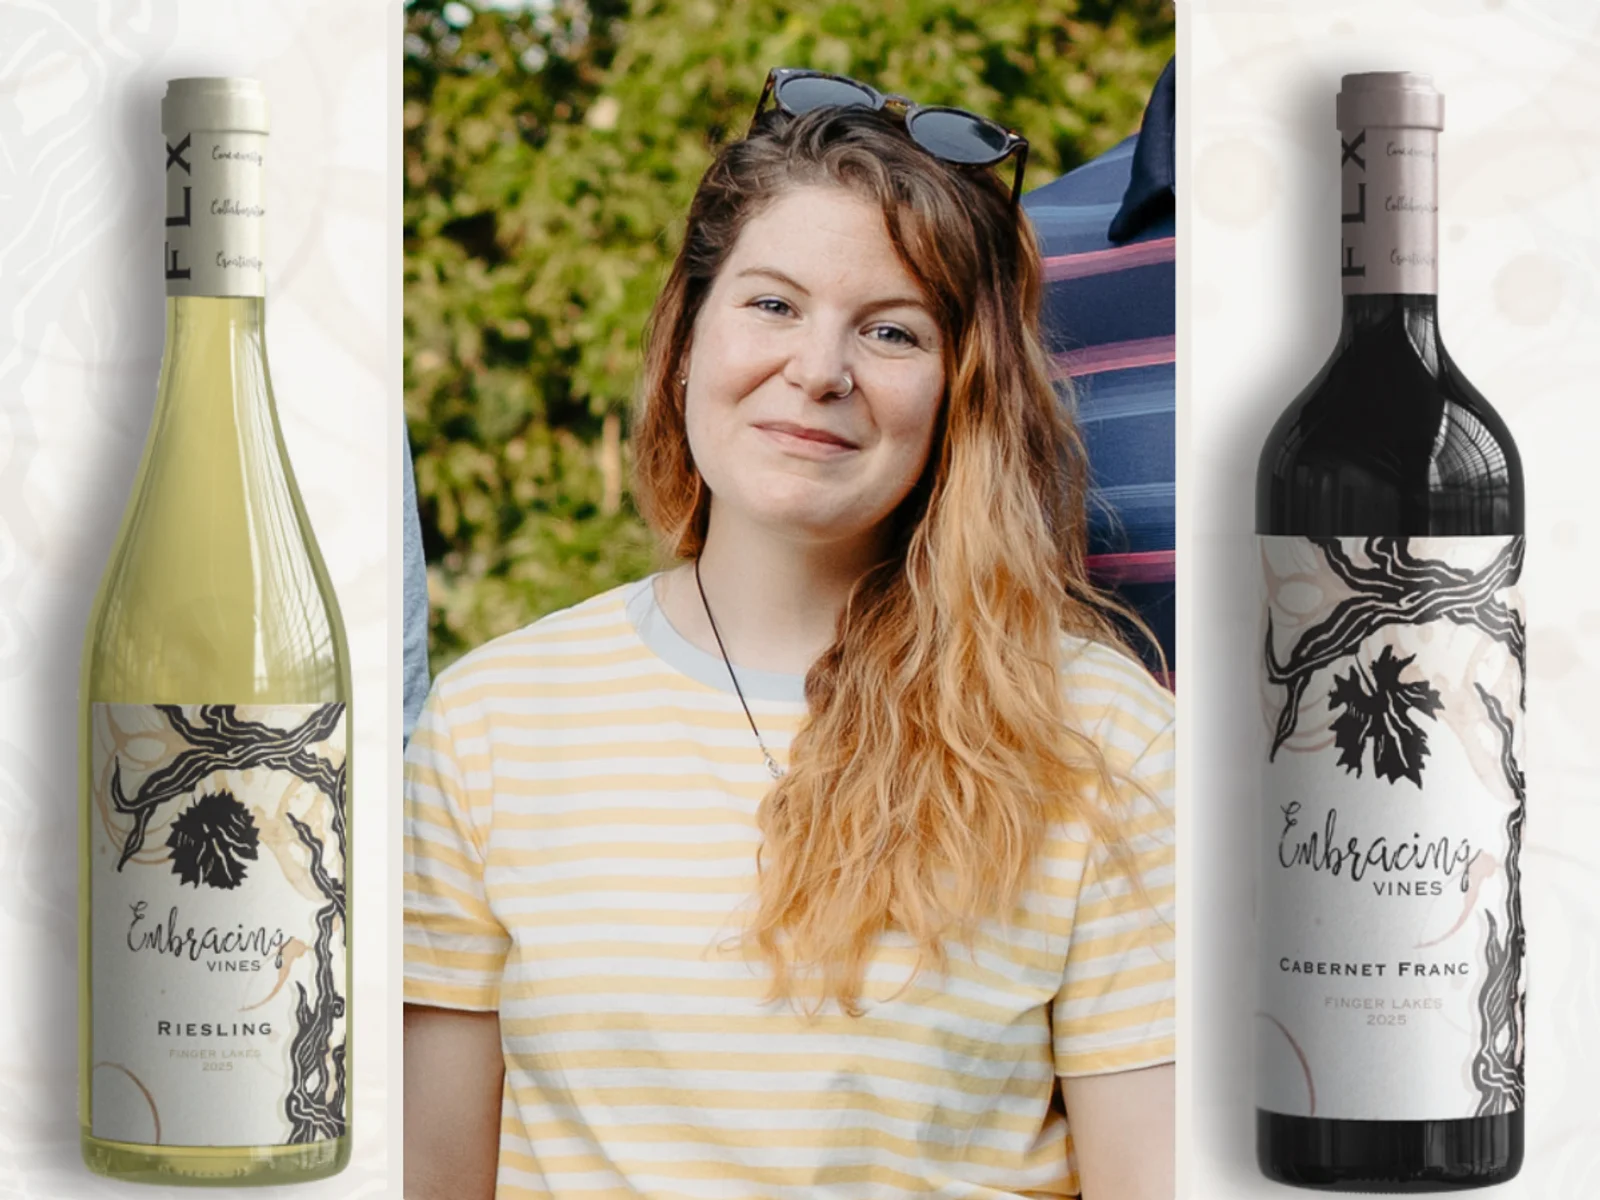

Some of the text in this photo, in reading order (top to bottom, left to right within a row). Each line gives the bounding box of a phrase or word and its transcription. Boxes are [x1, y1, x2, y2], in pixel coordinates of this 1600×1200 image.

[165, 132, 191, 280] FLX
[1341, 128, 1366, 277] FLX
[1279, 801, 1482, 892] Embracing
[1373, 881, 1443, 896] VINES
[127, 901, 294, 969] Embracing
[207, 960, 261, 972] VINES
[1280, 957, 1470, 977] CABERNET FRANC
[1324, 997, 1443, 1010] FINGER LAKES
[1366, 1014, 1407, 1026] 2025
[158, 1021, 272, 1036] RIESLING
[169, 1049, 262, 1059] FINGER LAKES
[202, 1061, 233, 1072] 2025
